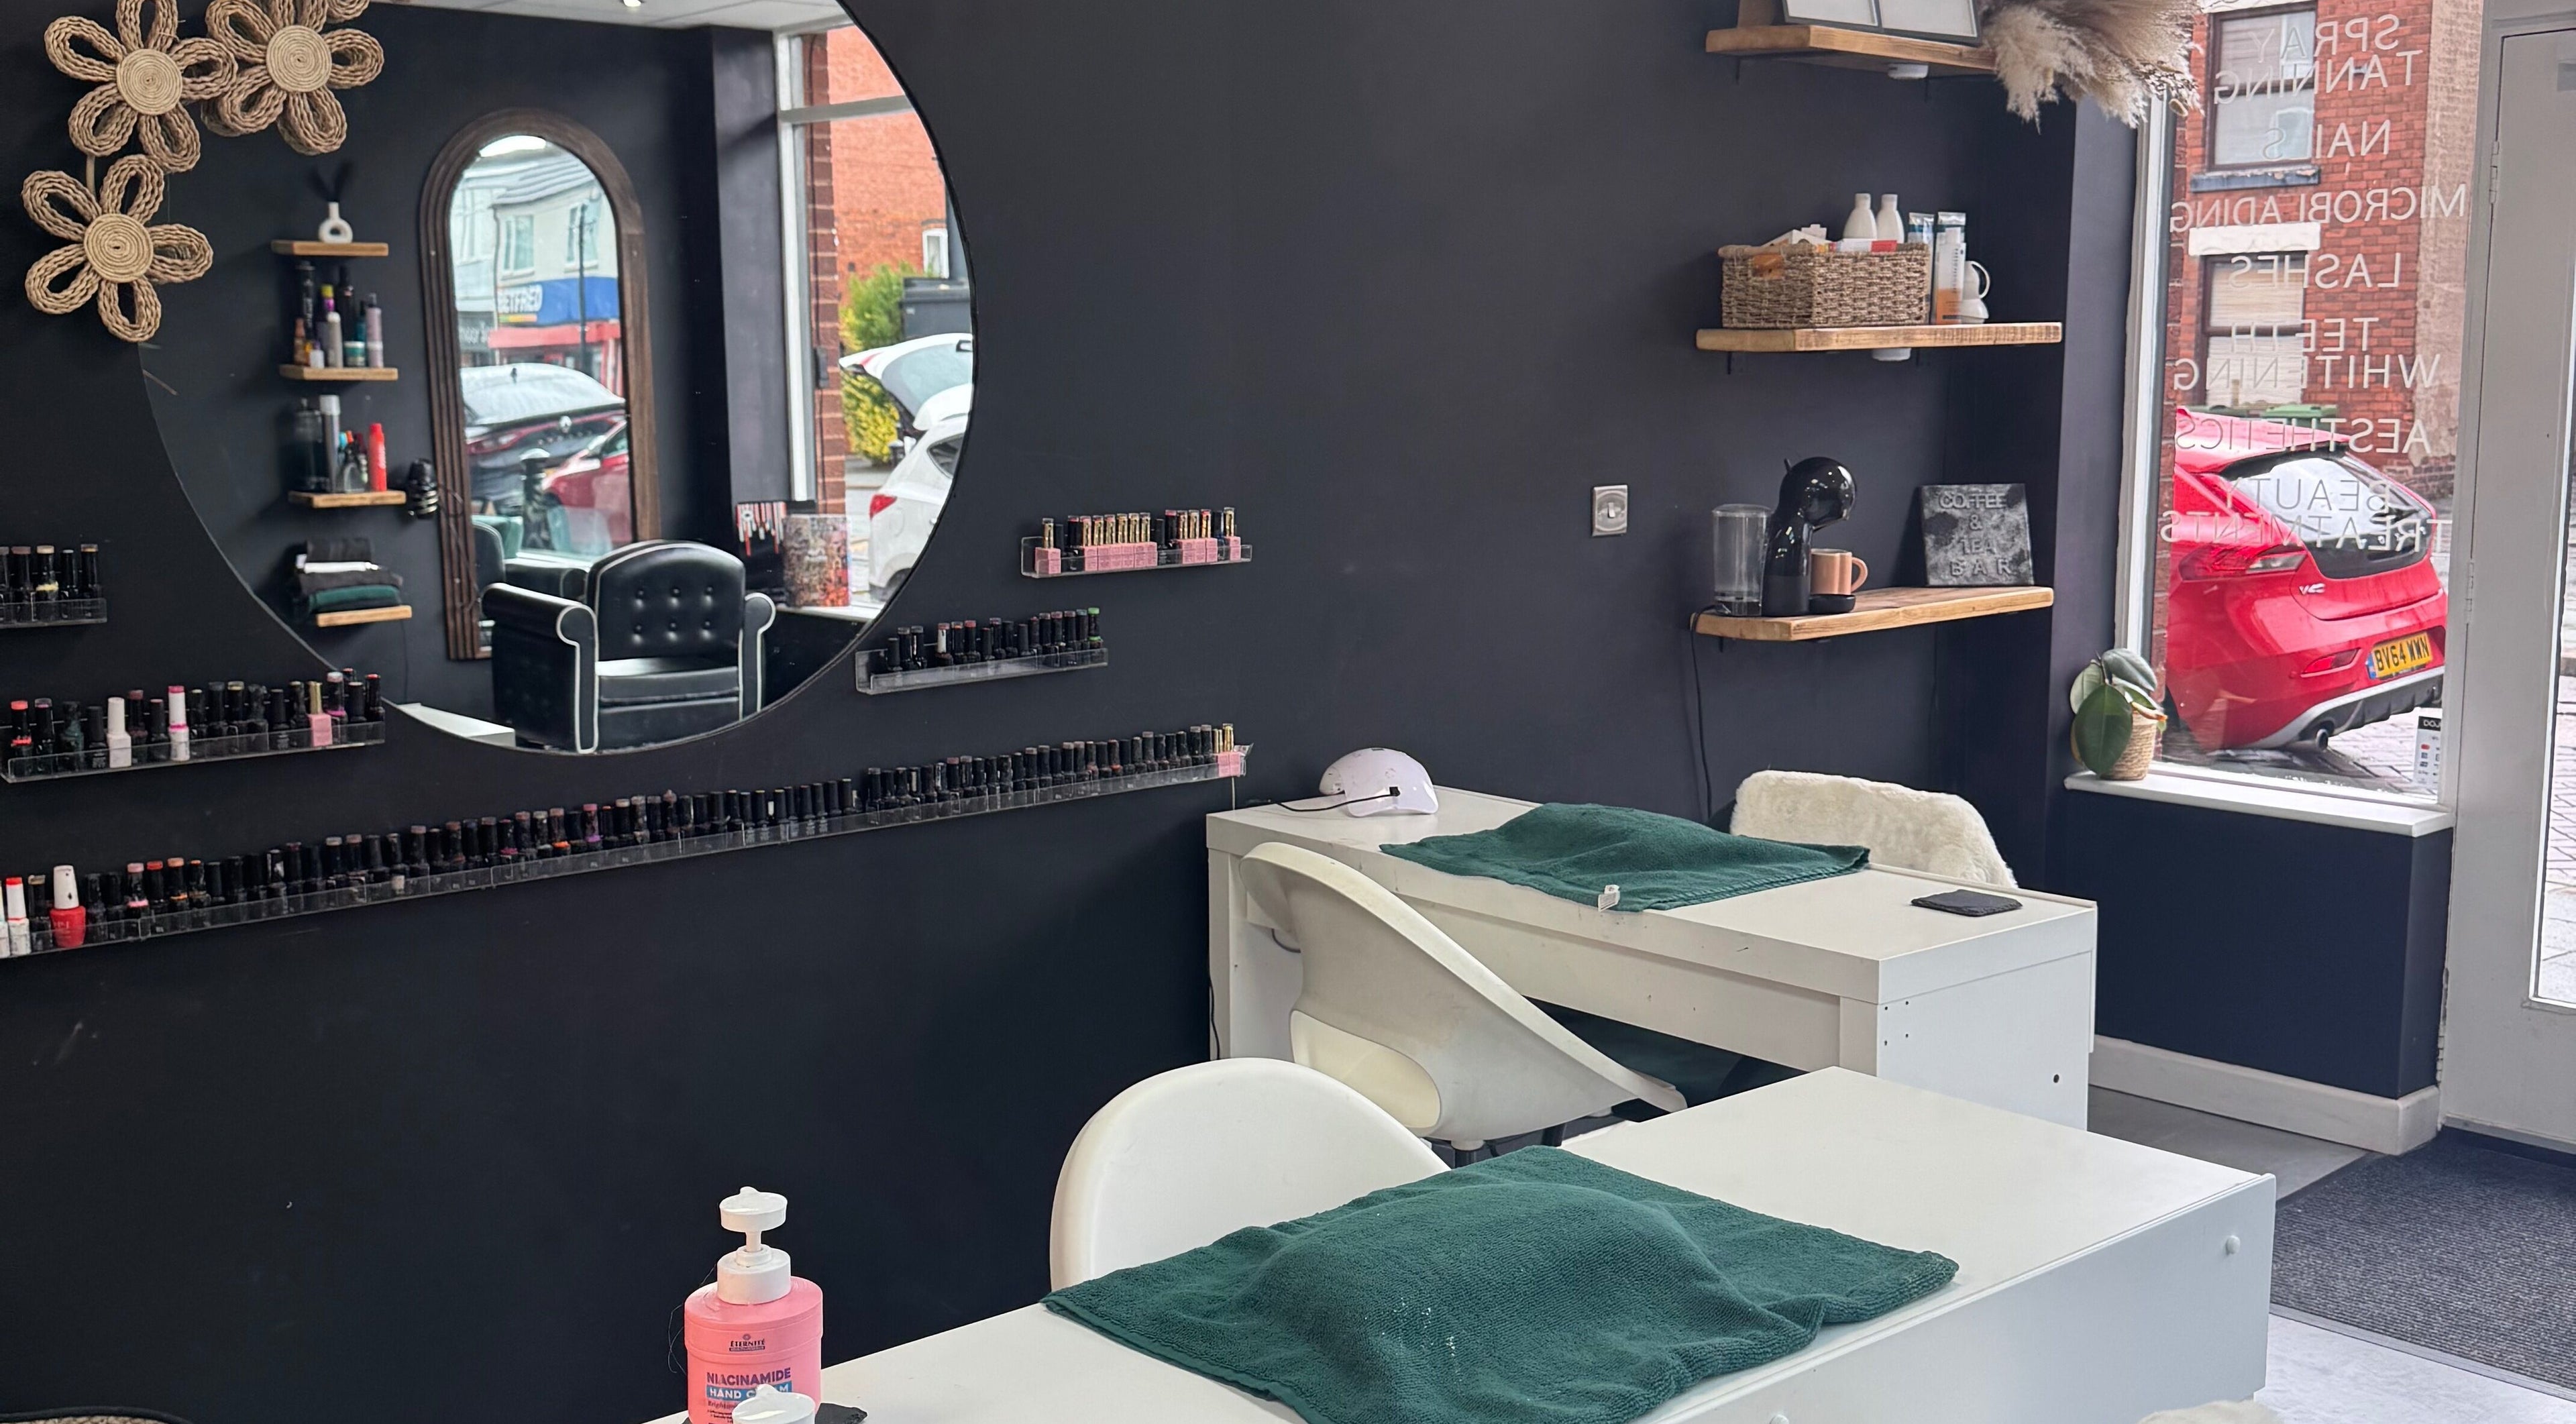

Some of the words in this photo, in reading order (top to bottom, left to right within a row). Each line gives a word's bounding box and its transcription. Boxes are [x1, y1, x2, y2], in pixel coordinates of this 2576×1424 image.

[1939, 492, 2006, 509] COFFEE
[1969, 514, 1983, 531] &
[1960, 539, 1997, 555] TEA
[2374, 643, 2406, 671] BV64
[2422, 719, 2441, 728] DOJ
[706, 1367, 791, 1386] NIACINAMIDE
[710, 1388, 741, 1399] HAND
